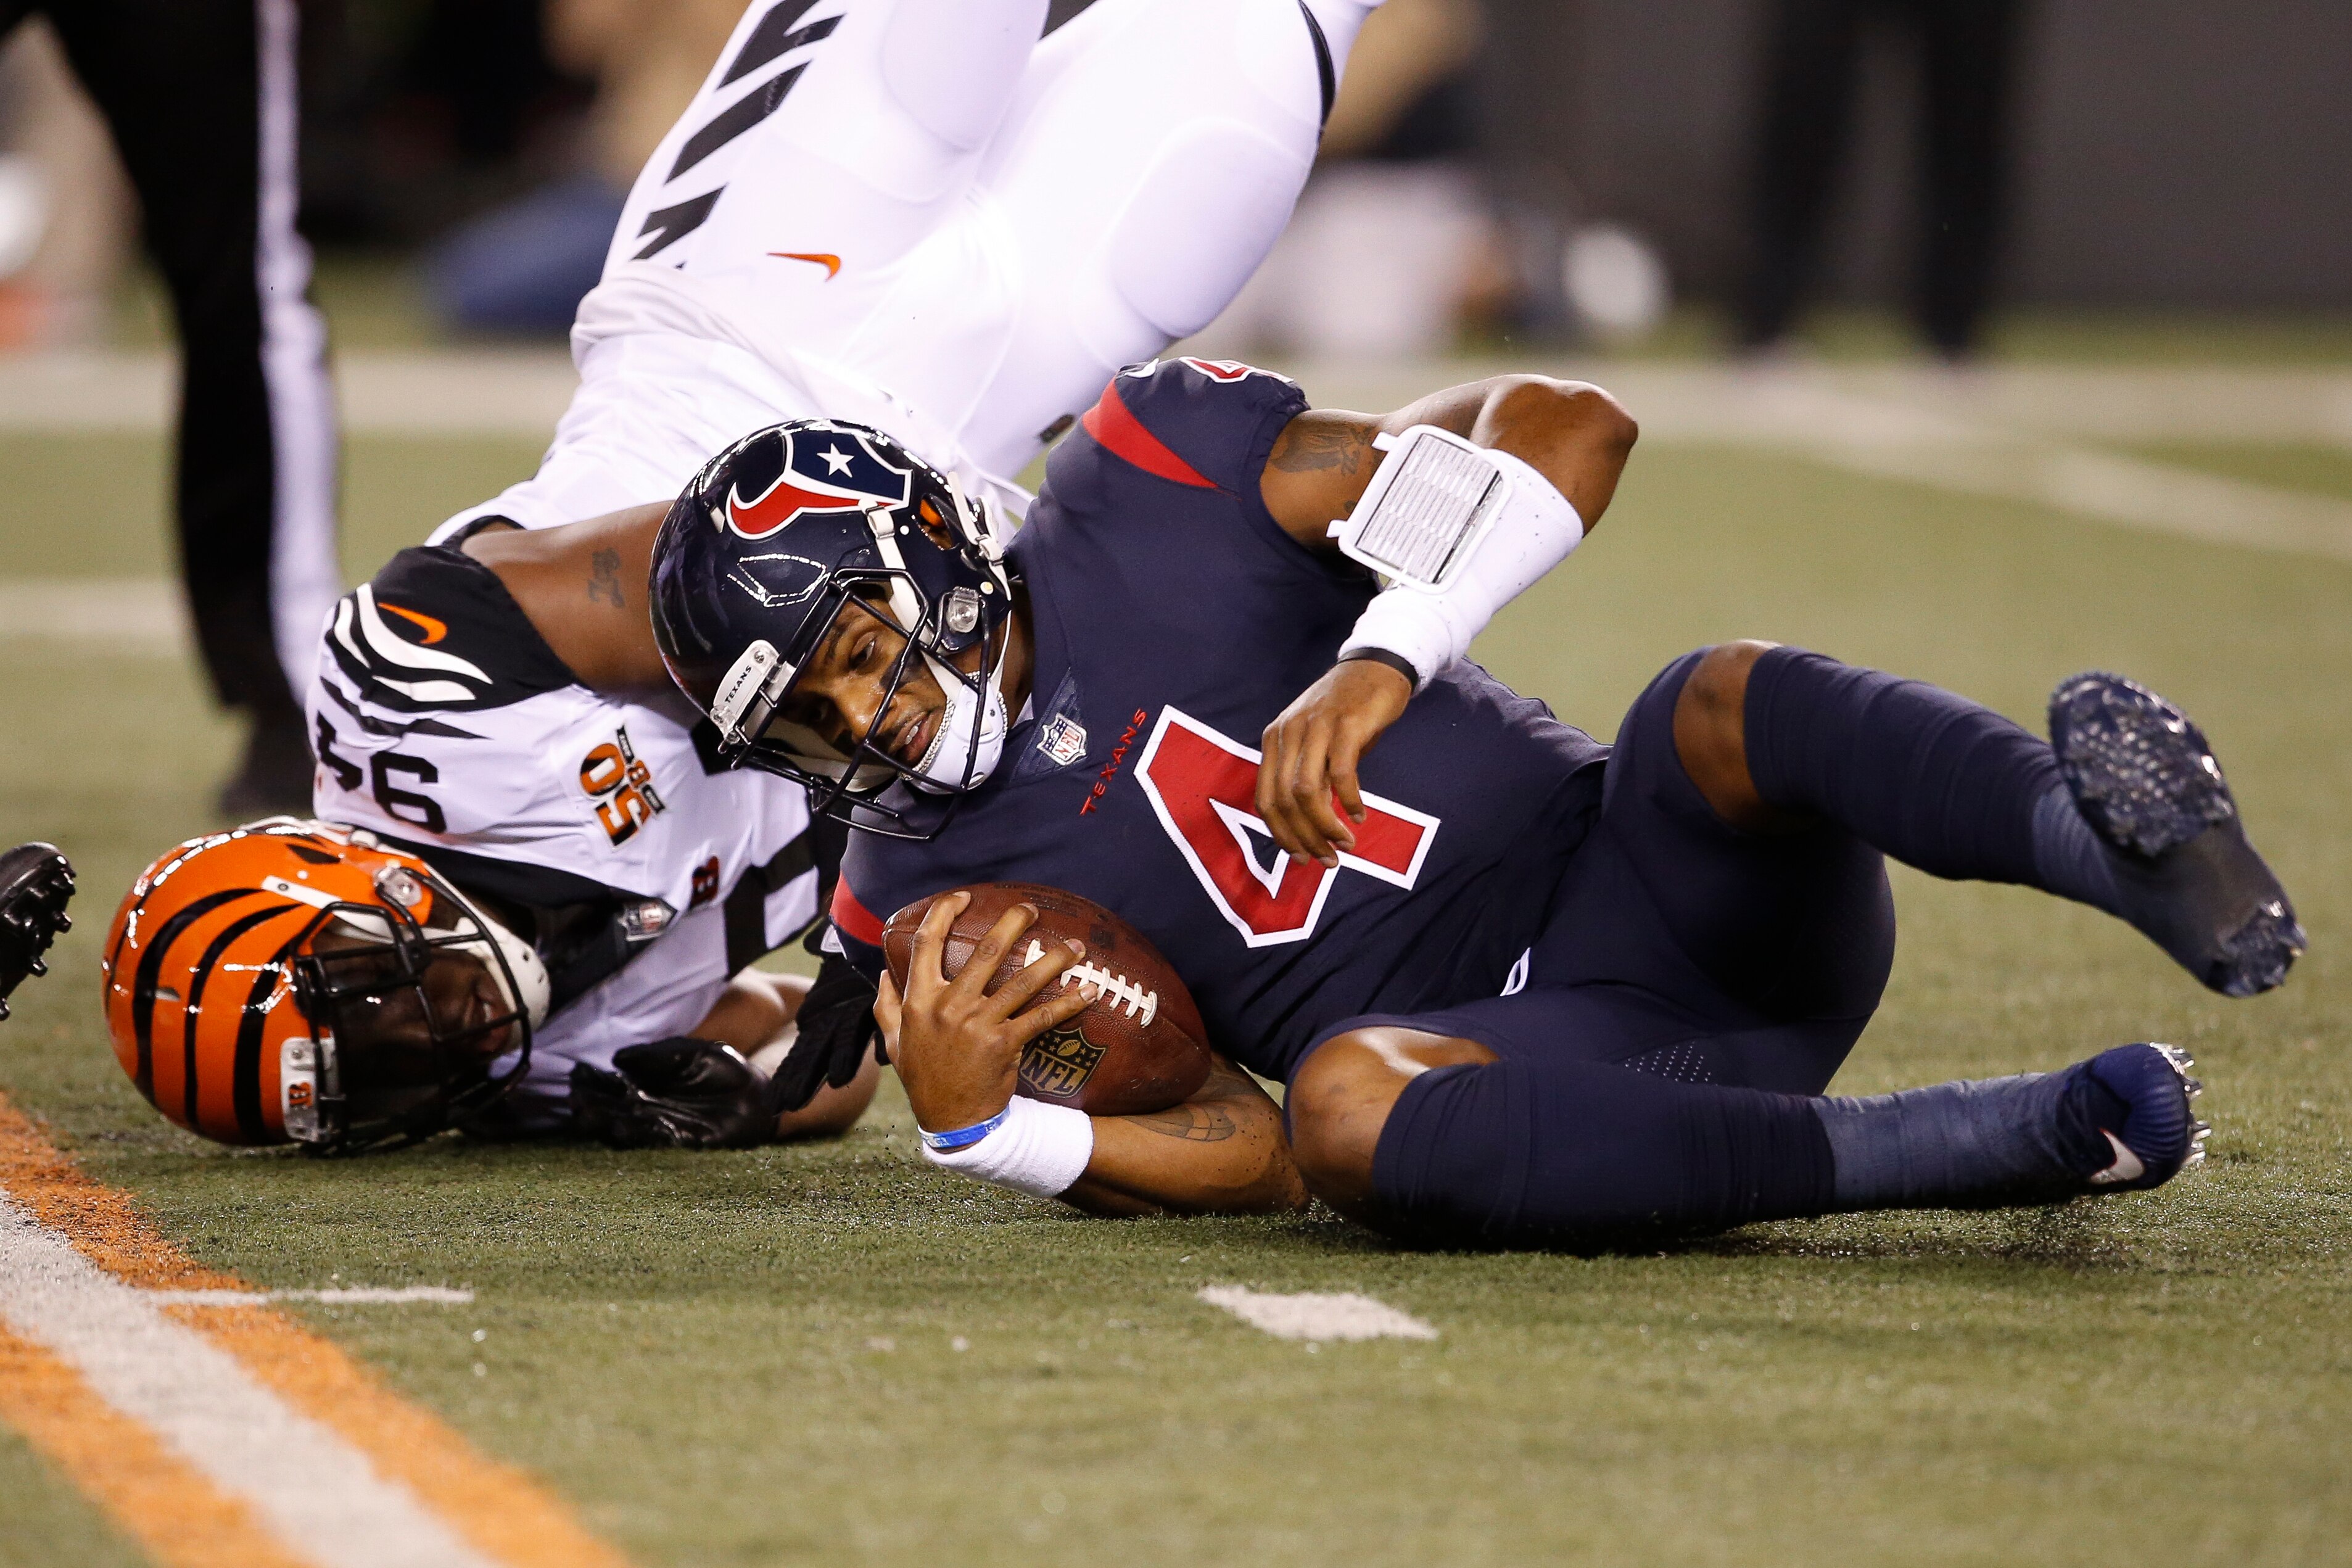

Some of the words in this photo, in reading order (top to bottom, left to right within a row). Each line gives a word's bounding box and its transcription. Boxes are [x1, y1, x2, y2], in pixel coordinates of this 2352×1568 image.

[725, 666, 751, 703] TEXANS
[1055, 728, 1081, 761] NFL
[1079, 707, 1147, 816] TEXANS
[580, 743, 651, 846] 50
[1133, 704, 1440, 948] 4
[1021, 1050, 1079, 1092] NFL
